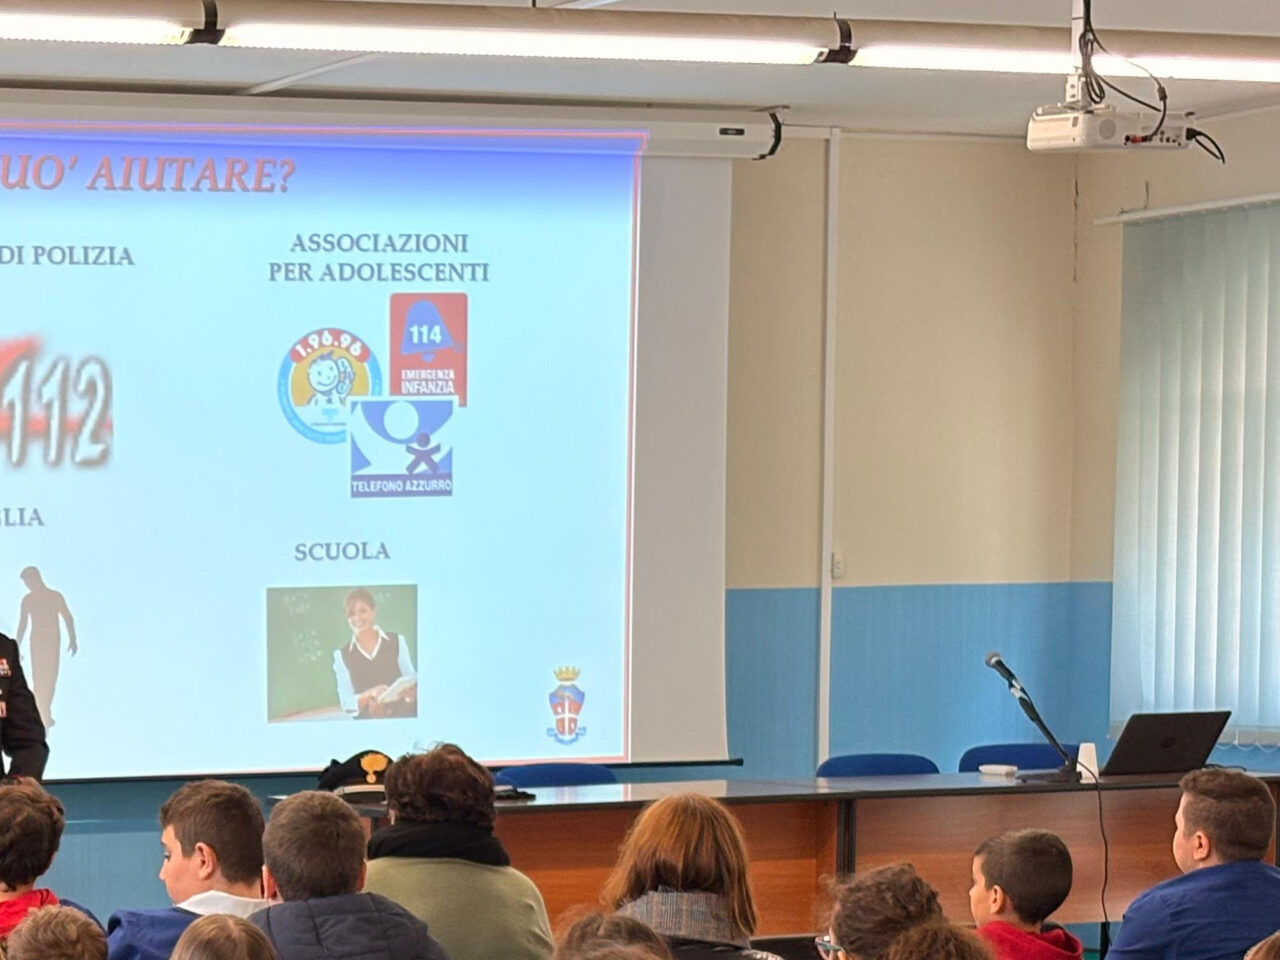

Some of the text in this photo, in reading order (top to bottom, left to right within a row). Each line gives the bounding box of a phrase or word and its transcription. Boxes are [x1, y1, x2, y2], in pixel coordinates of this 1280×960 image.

[86, 155, 297, 192] AIUTARE?
[290, 233, 469, 253] ASSOCIAZIONI
[31, 245, 135, 266] POLIZIA
[268, 262, 490, 282] PER ADOLESCENTI
[294, 330, 363, 358] 1.96.96
[409, 324, 442, 344] 114
[400, 369, 456, 381] EMERGENZA
[400, 381, 456, 394] INFANZIA
[351, 479, 453, 492] TELEFONO AZZURRO
[294, 541, 391, 562] SCUOLA
